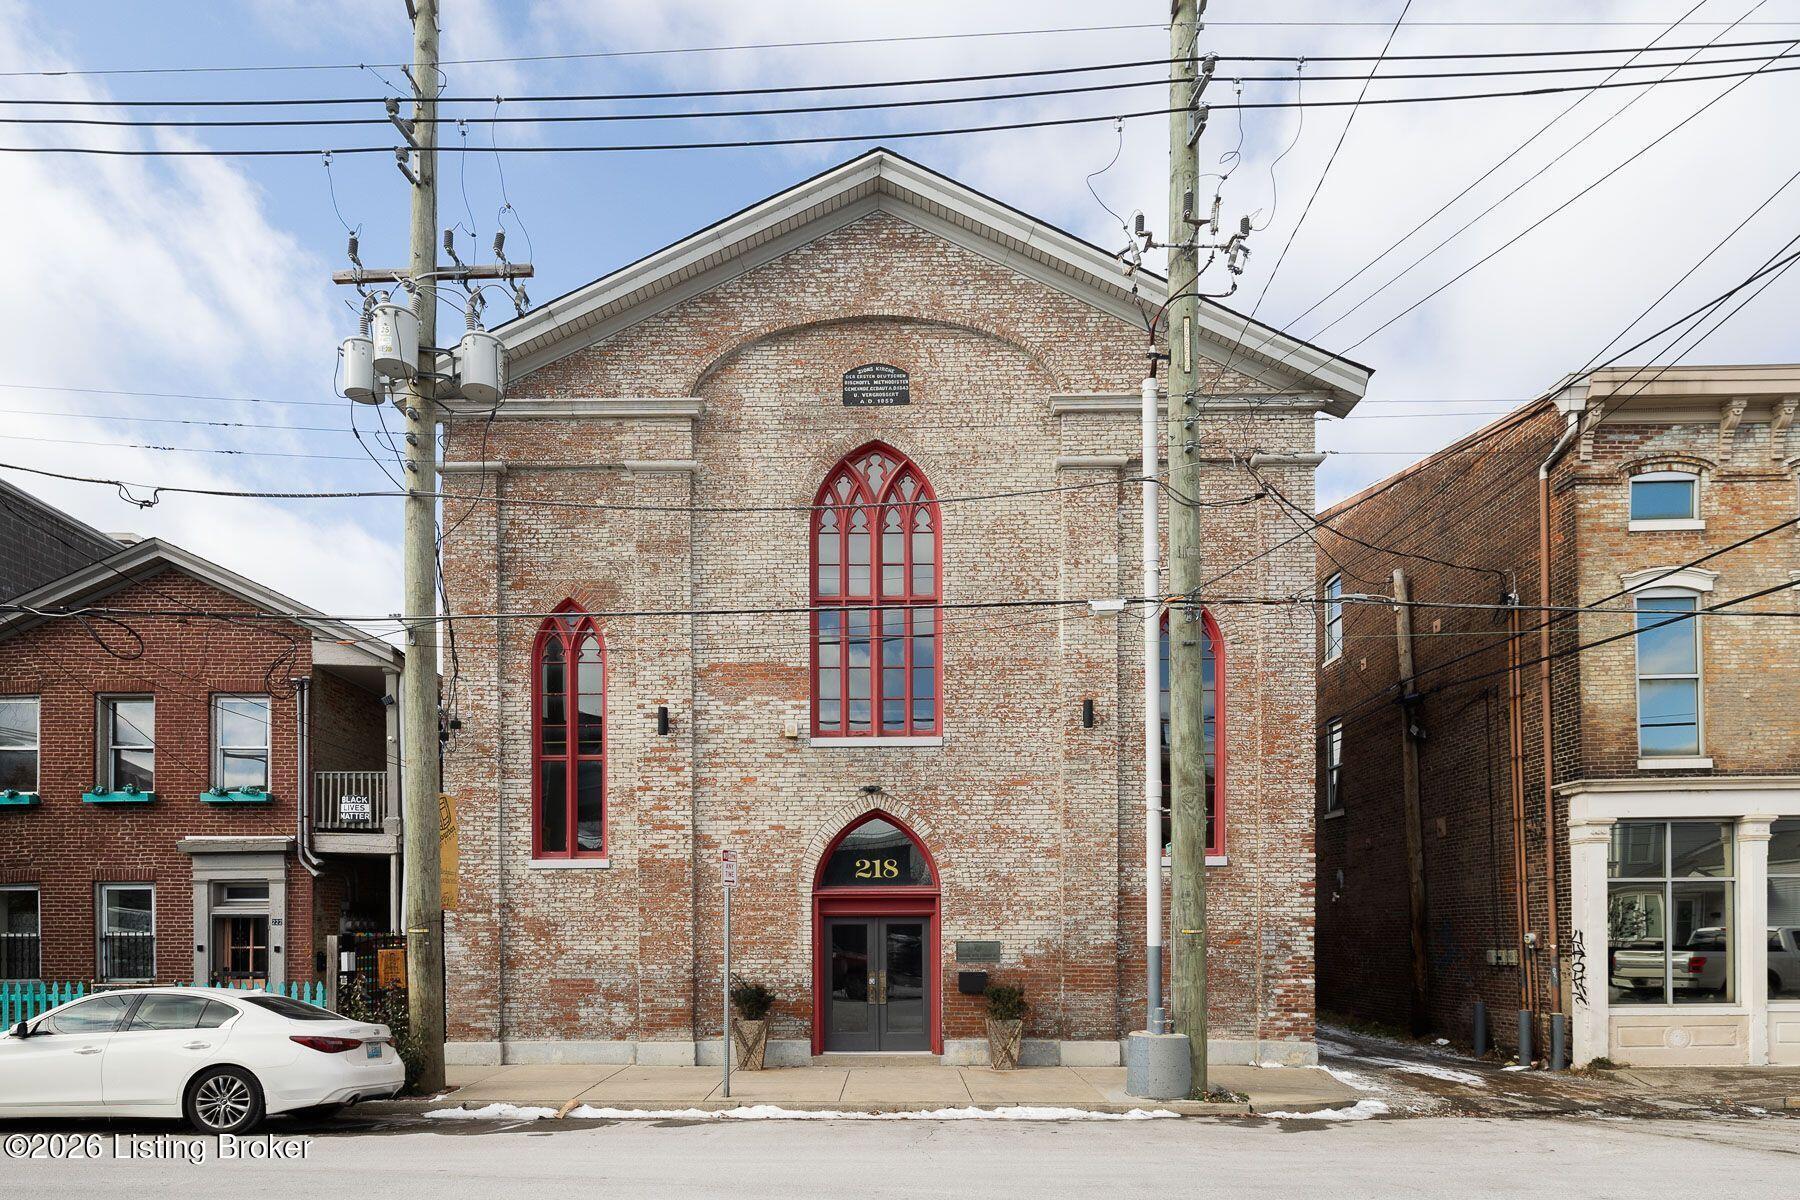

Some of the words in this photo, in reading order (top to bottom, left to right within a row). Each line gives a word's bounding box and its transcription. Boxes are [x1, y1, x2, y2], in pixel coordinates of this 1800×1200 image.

[857, 366, 874, 374] ZIONS
[340, 812, 370, 820] MATTER
[855, 859, 899, 878] 218
